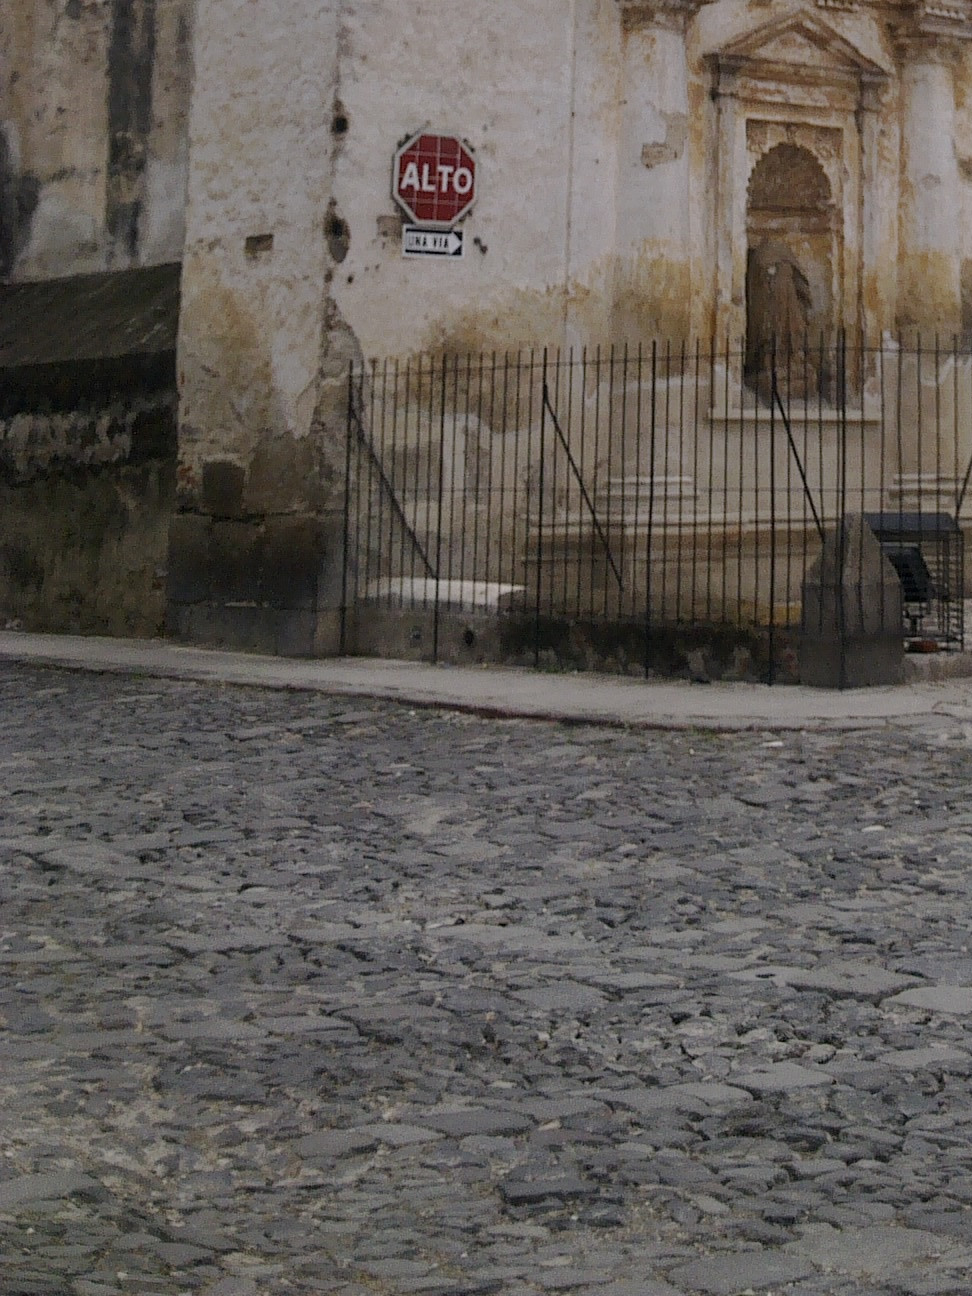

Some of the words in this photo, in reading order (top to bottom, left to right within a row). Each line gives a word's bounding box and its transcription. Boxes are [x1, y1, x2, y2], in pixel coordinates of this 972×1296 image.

[400, 162, 473, 194] ALTO
[407, 235, 428, 247] UNA
[433, 236, 449, 248] VIA
